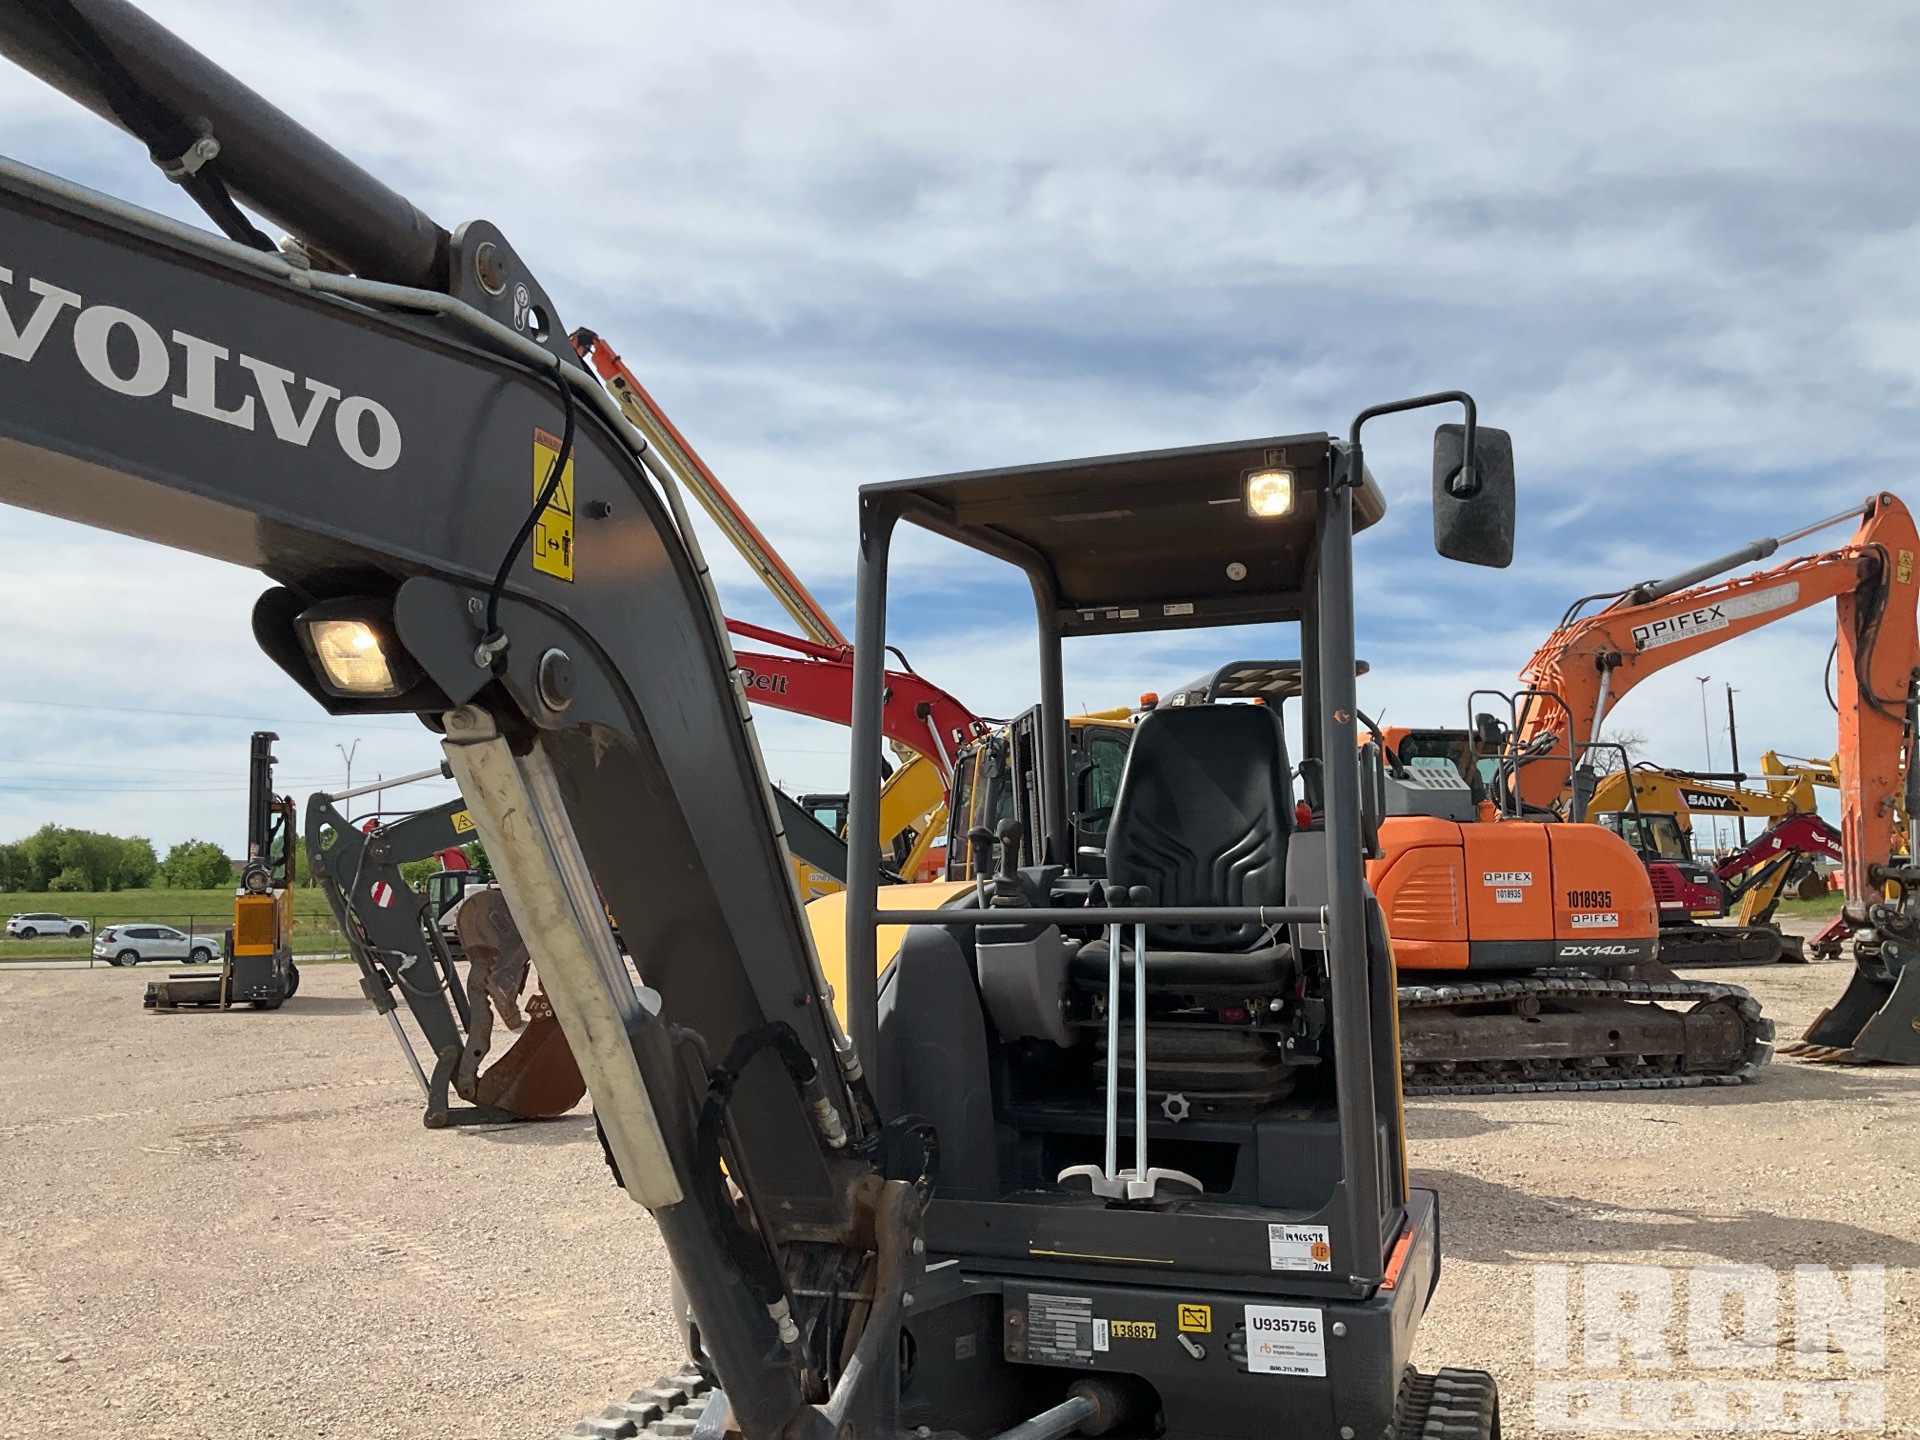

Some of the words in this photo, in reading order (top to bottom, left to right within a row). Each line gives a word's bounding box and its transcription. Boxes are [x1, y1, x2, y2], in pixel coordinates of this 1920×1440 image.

[0, 266, 402, 470] VOLVO
[1632, 605, 1725, 640] OPIFEX
[740, 667, 787, 693] Belt
[1687, 794, 1727, 808] SANY
[1484, 873, 1531, 881] OPIFEX
[1496, 889, 1521, 899] 1018935
[1566, 890, 1612, 909] 1018935
[1571, 914, 1618, 923] OPIFEX
[1315, 1246, 1327, 1257] IP
[1113, 1325, 1155, 1338] 138887
[1252, 1317, 1317, 1334] U935756
